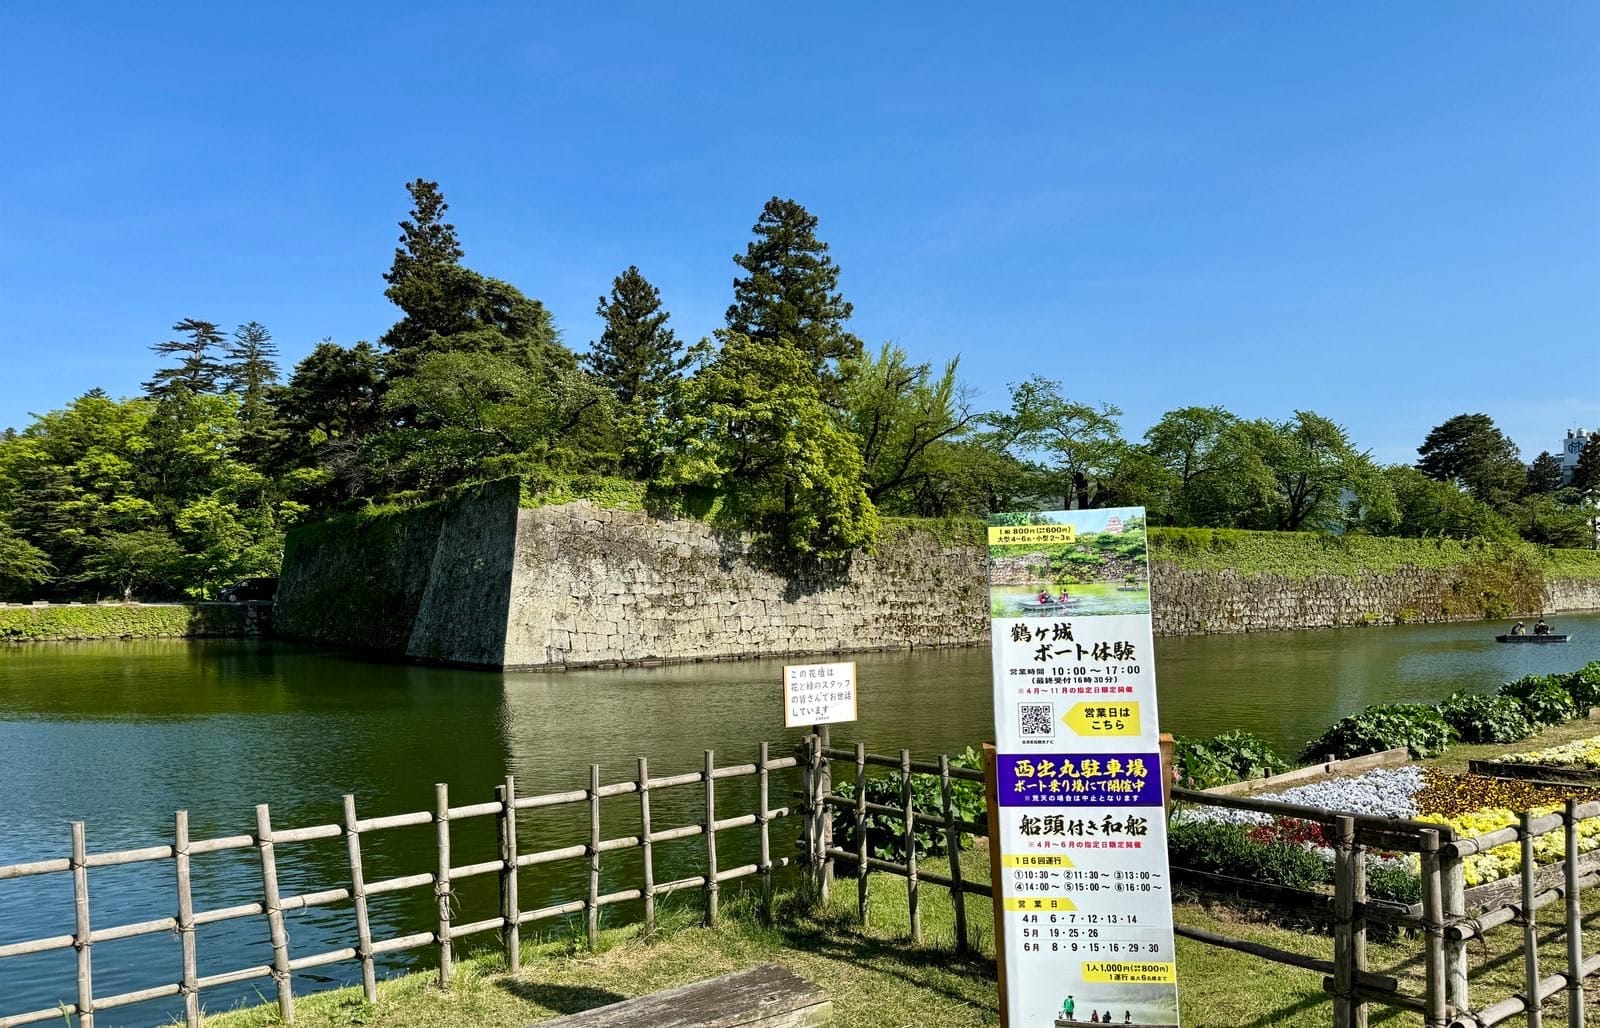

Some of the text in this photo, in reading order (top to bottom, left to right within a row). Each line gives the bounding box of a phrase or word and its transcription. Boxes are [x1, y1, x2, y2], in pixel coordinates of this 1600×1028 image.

[1033, 641, 1137, 662] ボート体験
[791, 667, 834, 679] この花壇は
[1009, 668, 1045, 676] 営業時間
[791, 679, 851, 692] 花と緑のスタッフ
[1084, 707, 1131, 718] 営業日は
[1091, 719, 1125, 731] こちら
[1014, 759, 1148, 778] 西出丸駐車場
[1014, 779, 1146, 793] ボート乗り場にて開催中
[1018, 814, 1148, 836] 船頭付き和船
[1015, 856, 1062, 866] 1日6回運行
[1022, 914, 1038, 923] 4月
[1023, 928, 1039, 938] 5月
[1024, 943, 1040, 952] 6月
